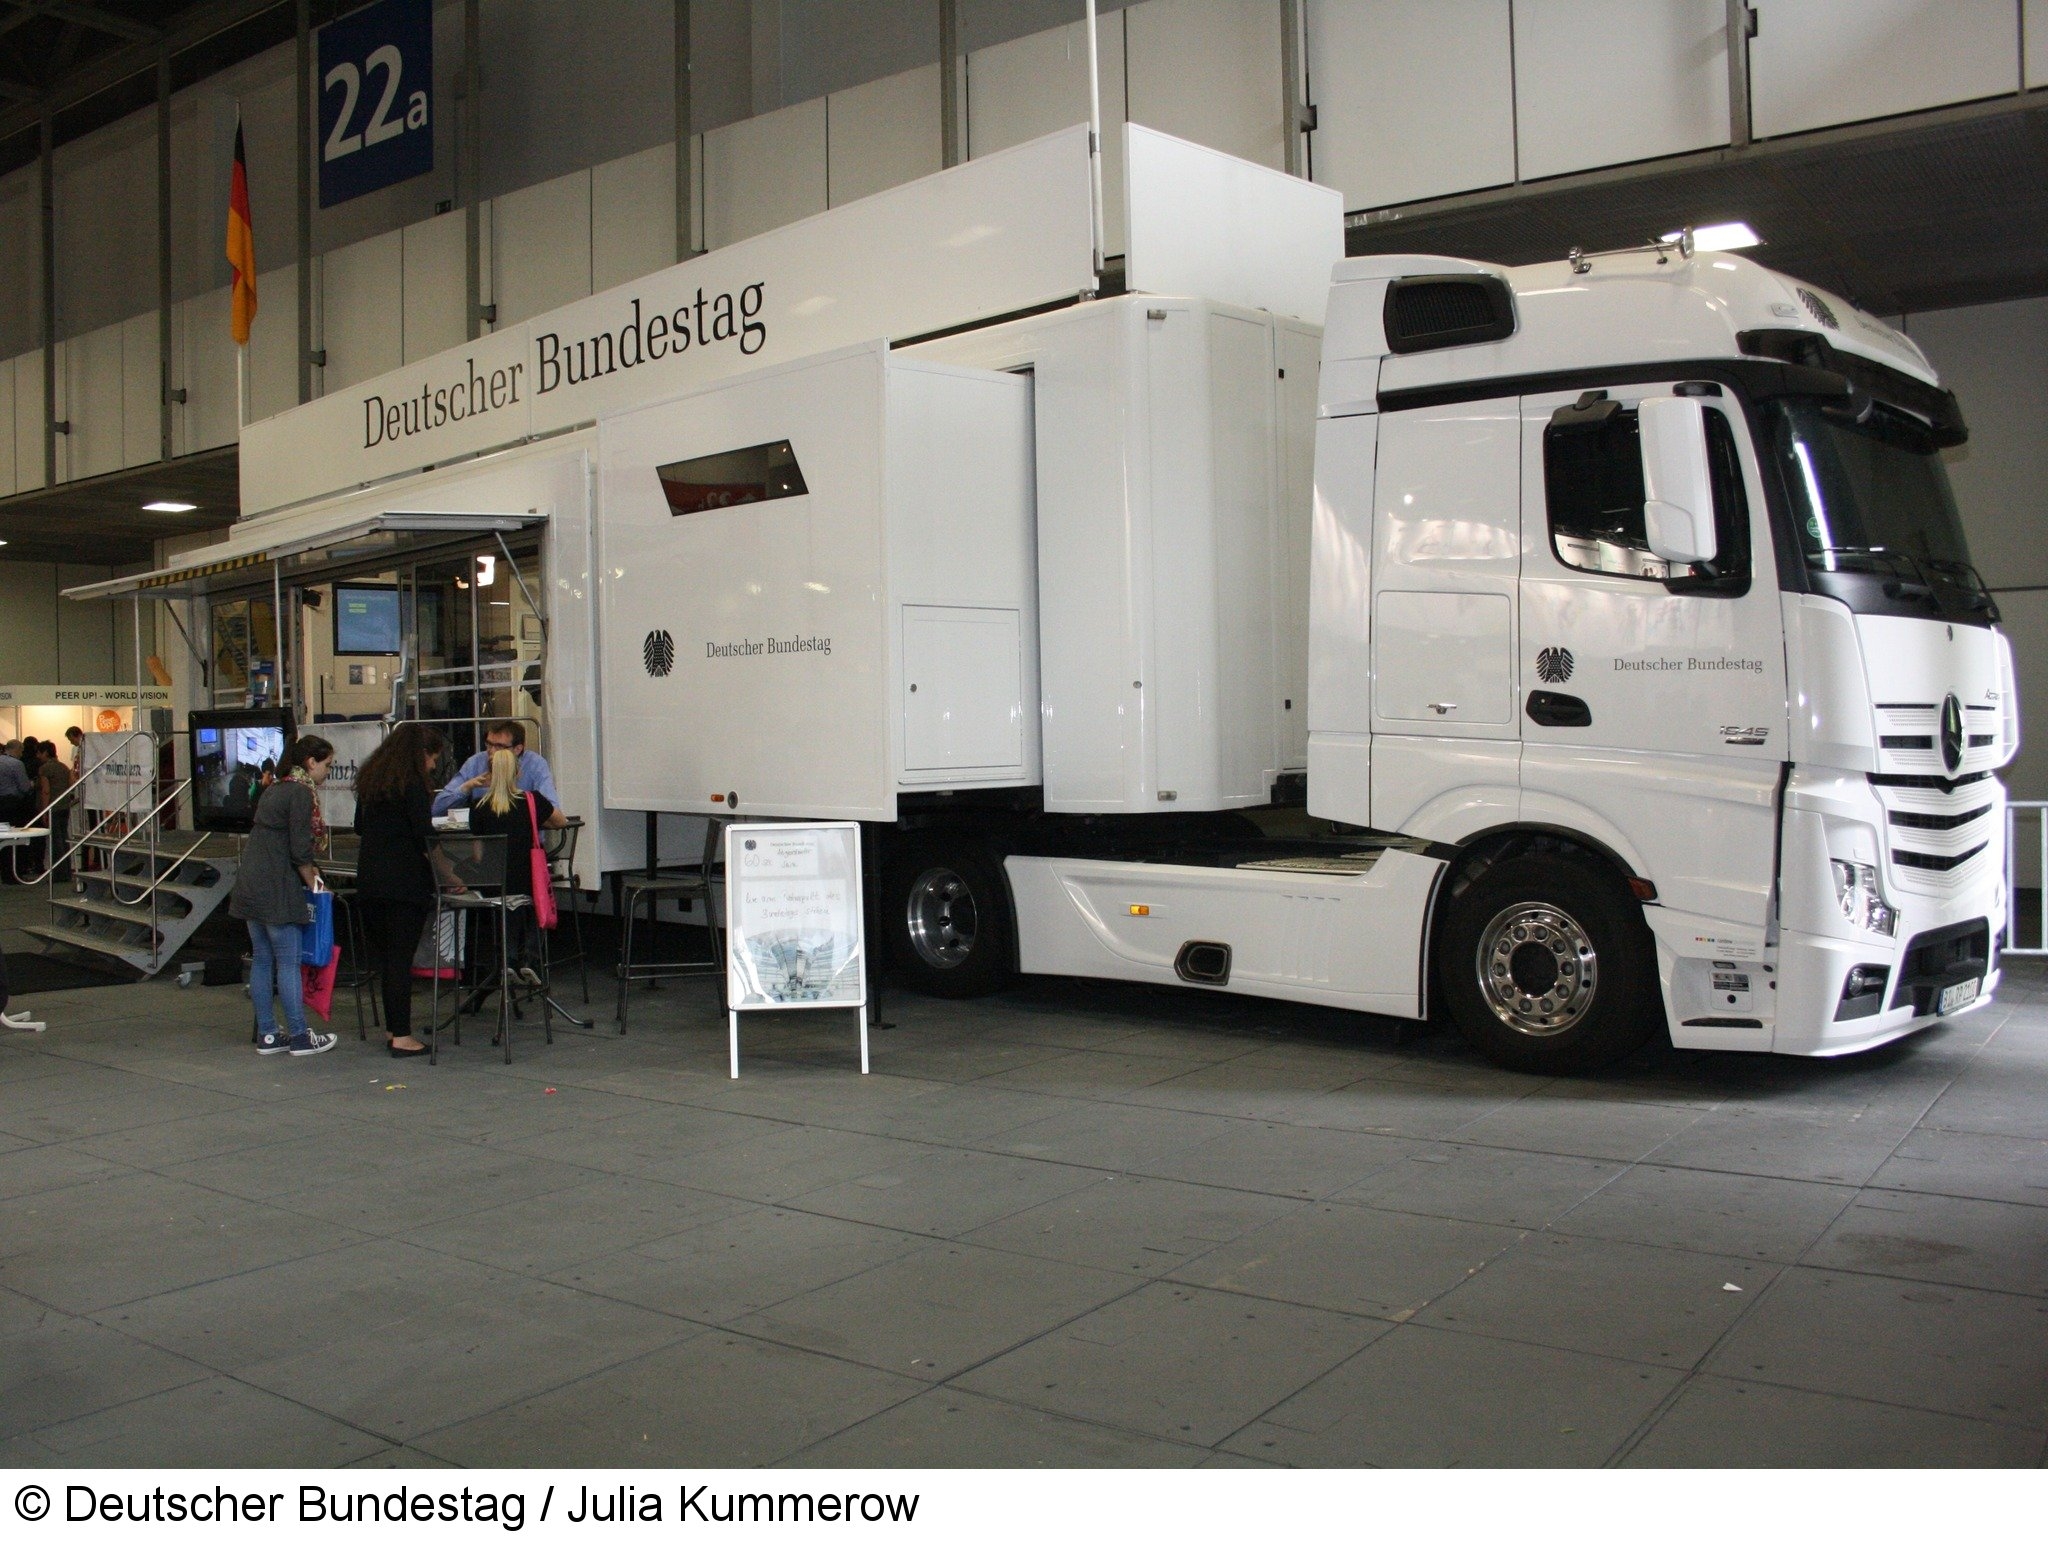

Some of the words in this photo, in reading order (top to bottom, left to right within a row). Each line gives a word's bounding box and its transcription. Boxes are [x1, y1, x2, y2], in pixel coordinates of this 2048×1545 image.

[325, 45, 427, 162] 22a
[363, 358, 524, 449] Deutscher
[535, 281, 767, 395] Bundestag
[706, 639, 764, 658] Deutscher
[767, 635, 831, 656] Bundestag
[1614, 657, 1683, 671] Deutscher
[1687, 657, 1763, 673] Bundestag
[55, 692, 80, 700] PEER
[82, 692, 98, 700] UP!
[105, 692, 137, 700] WORLD
[140, 692, 168, 700] VISION
[1720, 726, 1769, 736] 1845
